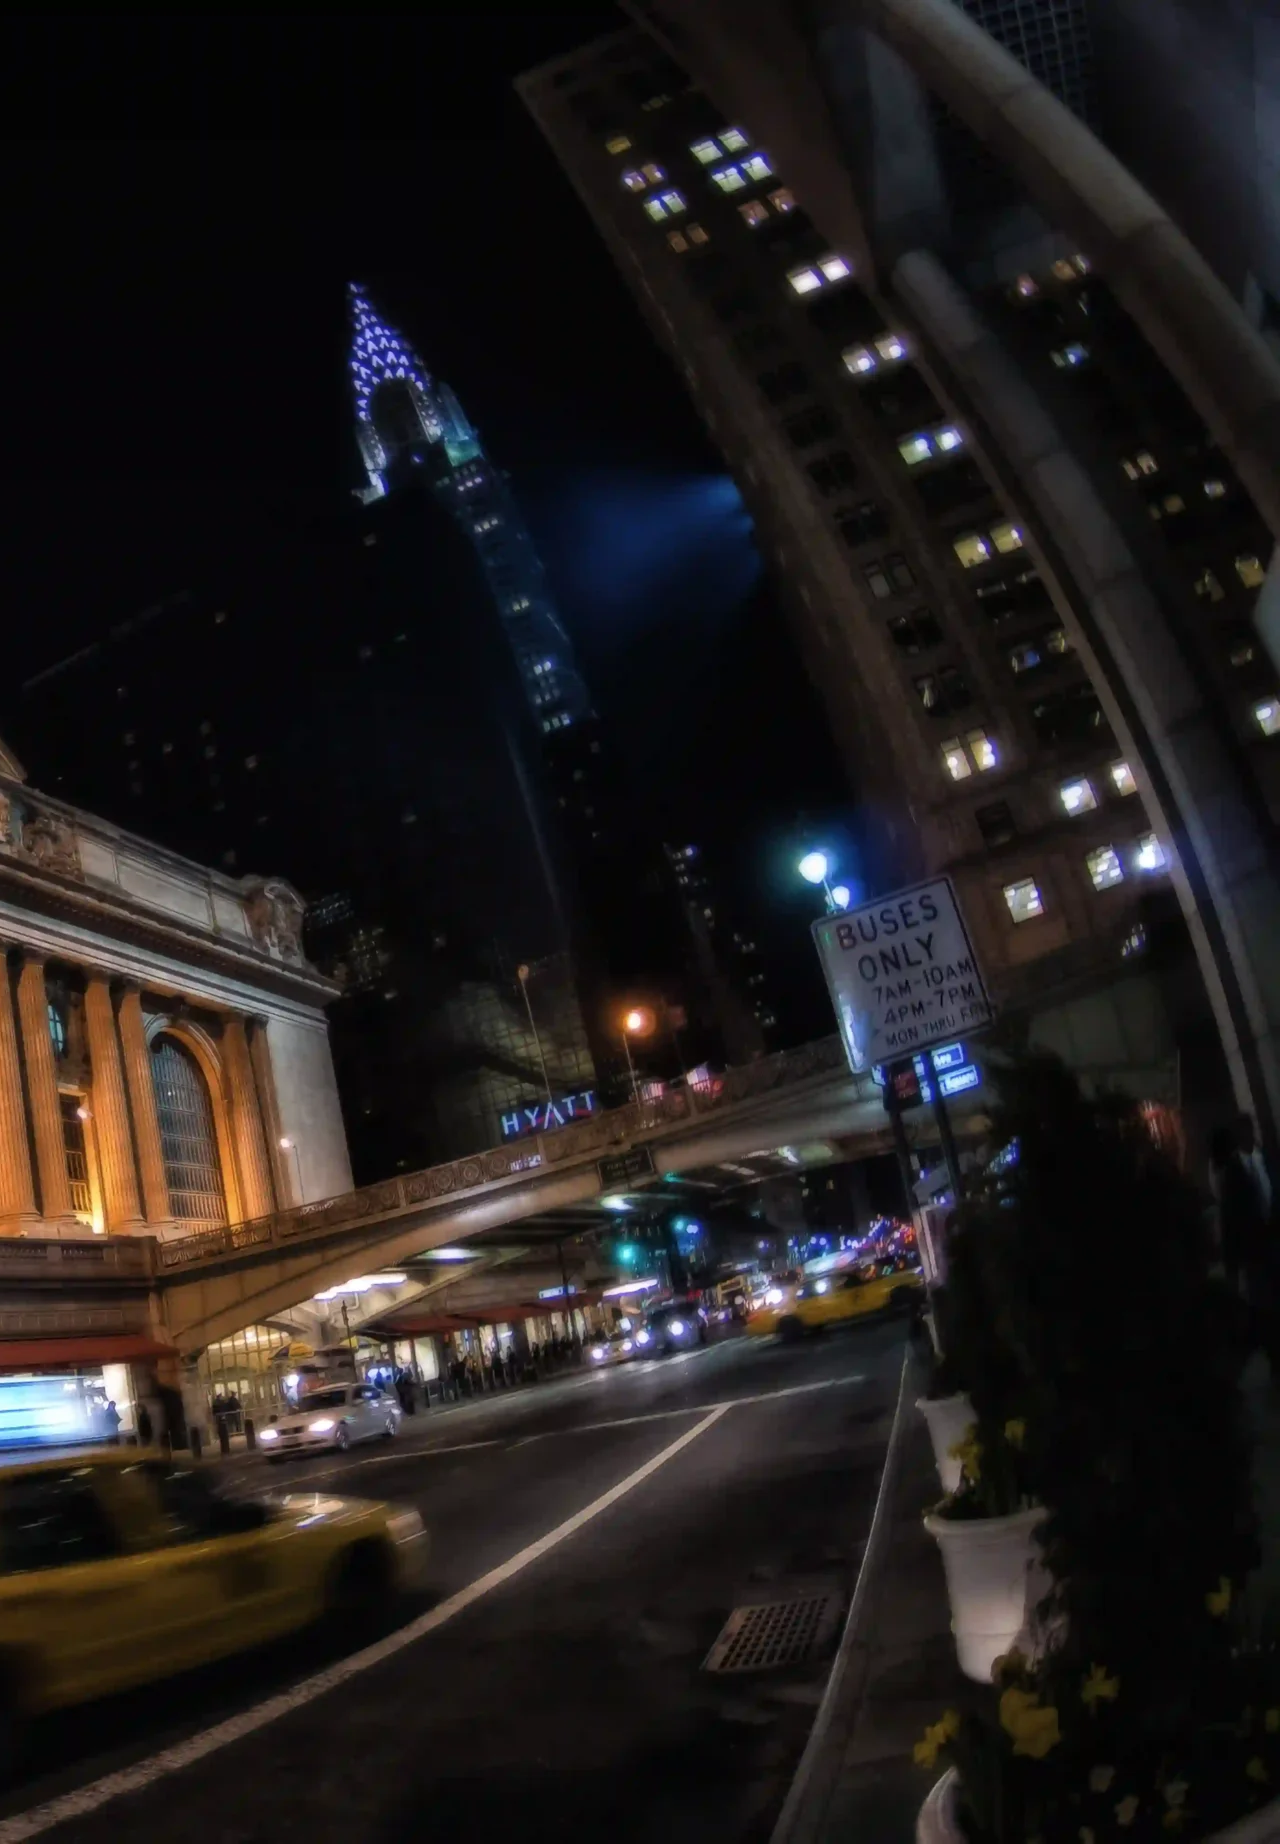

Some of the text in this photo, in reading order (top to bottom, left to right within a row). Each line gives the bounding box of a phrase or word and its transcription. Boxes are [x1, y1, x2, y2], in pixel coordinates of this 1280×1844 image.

[836, 894, 938, 950] BUSES
[858, 932, 933, 982] ONLY
[885, 1025, 919, 1047] MON
[923, 1014, 956, 1036] THRU
[501, 1090, 593, 1135] HYATT
